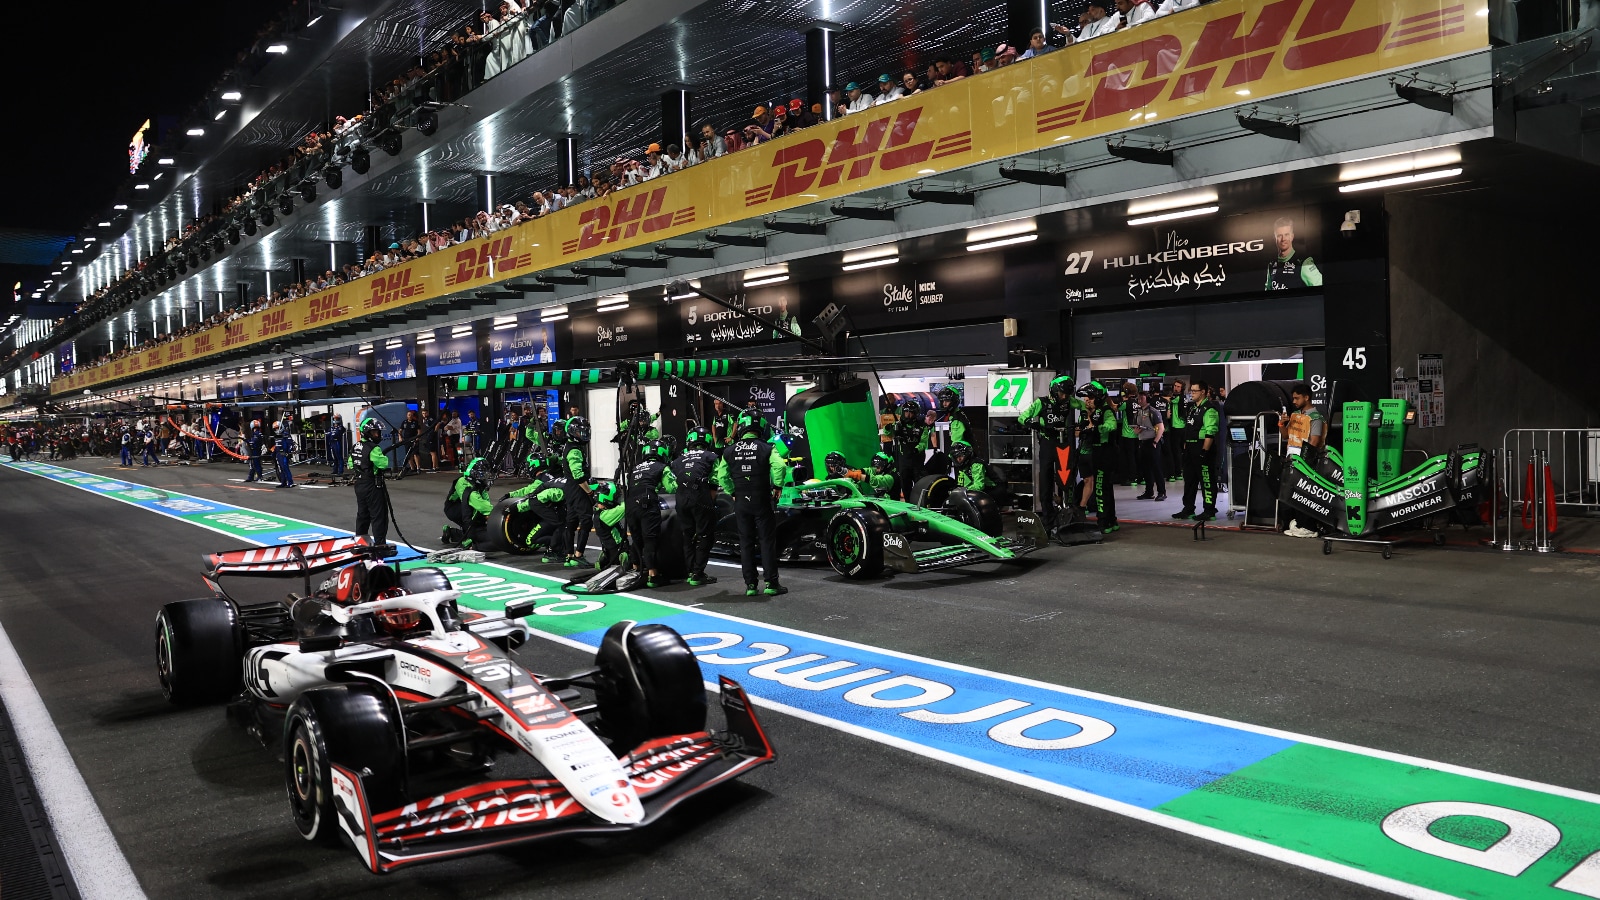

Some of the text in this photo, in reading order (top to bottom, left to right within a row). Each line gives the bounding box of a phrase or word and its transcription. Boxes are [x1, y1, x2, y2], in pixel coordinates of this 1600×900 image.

[1082, 0, 1391, 121] DHL
[771, 108, 936, 199] DHL
[578, 186, 675, 248] DHL
[1166, 230, 1189, 254] Nico
[455, 236, 518, 283] DHL
[1064, 250, 1094, 276] 27
[1103, 239, 1264, 270] HULKENBERG
[371, 268, 415, 306] DHL
[919, 281, 936, 292] KICK
[1128, 262, 1226, 300] نيكو هولكنبرغ
[883, 283, 912, 306] Stake
[919, 293, 944, 305] SAUBER
[309, 292, 342, 323] DHL
[688, 306, 697, 325] 5
[262, 309, 288, 335] DHL
[493, 340, 503, 352] 23
[509, 339, 533, 350] ALBON
[1237, 349, 1261, 359] NICO
[1342, 346, 1367, 370] 45
[668, 384, 677, 398] 42
[749, 386, 776, 401] Stake
[990, 377, 1029, 407] 27
[1347, 422, 1360, 431] FIX
[734, 441, 758, 452] Stake
[1095, 469, 1104, 513] PIT CREW
[1201, 465, 1213, 505] PIT CREW
[1296, 477, 1336, 504] MASCOT
[1344, 489, 1362, 500] Stake
[1384, 480, 1438, 506] MASCOT
[1291, 491, 1330, 516] WORKWEAR
[1347, 505, 1361, 521] K
[1390, 495, 1443, 519] WORKWEAR
[525, 523, 542, 546] CREW
[883, 533, 903, 549] Stake
[472, 663, 522, 682] 31
[681, 631, 1118, 751] aramco
[544, 728, 586, 742] ZOOMEX
[631, 736, 716, 788] Gram
[394, 792, 577, 837] Money
